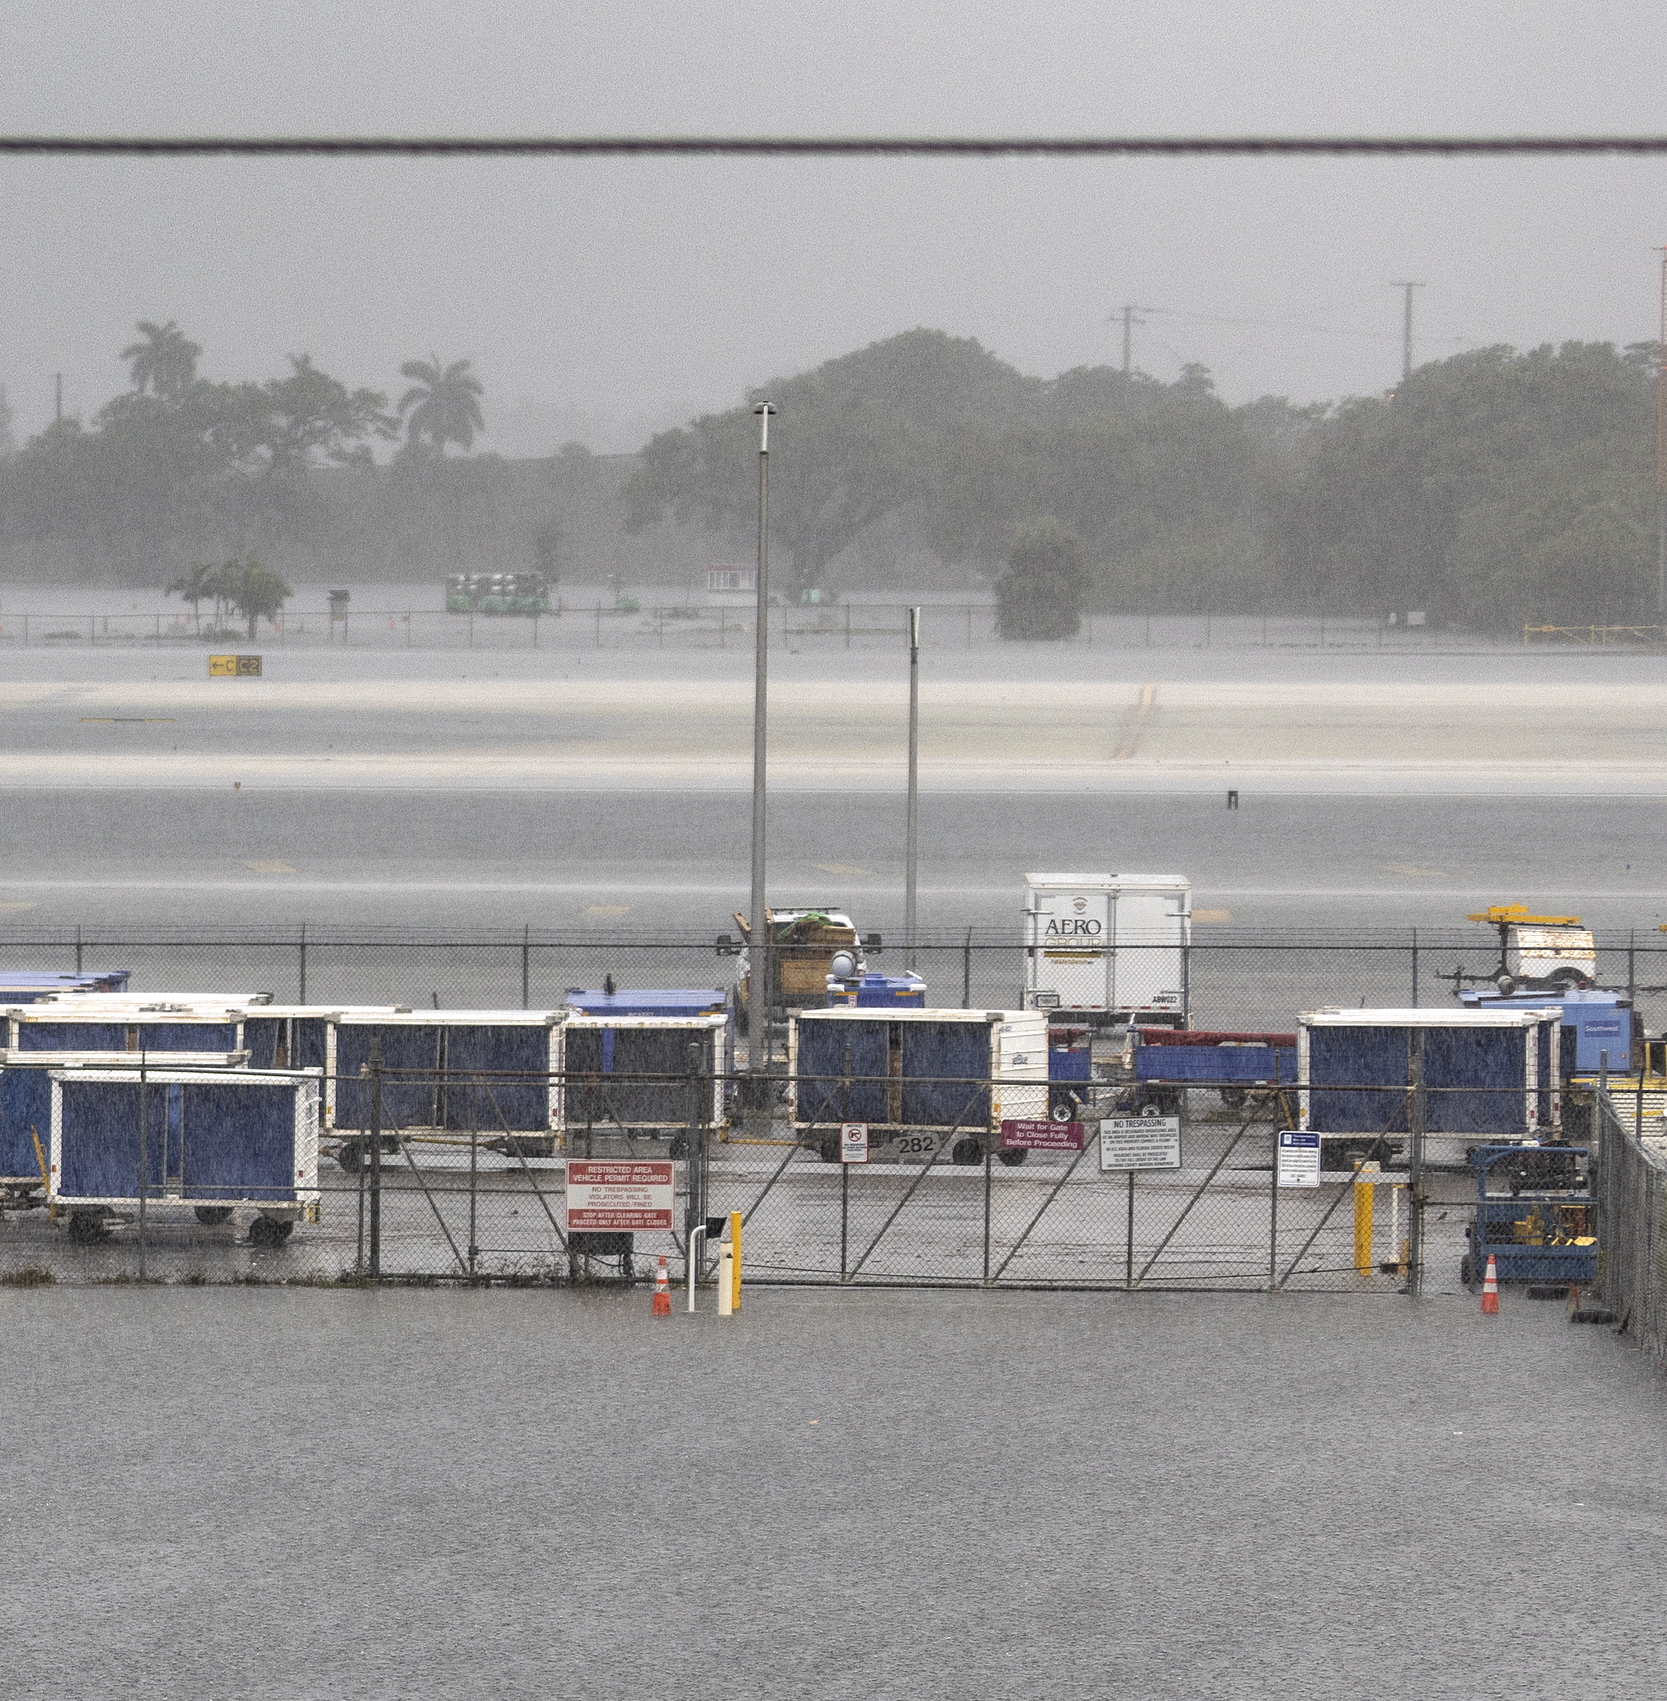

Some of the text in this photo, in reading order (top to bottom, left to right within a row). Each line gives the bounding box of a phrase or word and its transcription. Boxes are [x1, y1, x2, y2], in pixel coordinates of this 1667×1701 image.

[1045, 919, 1101, 935] AERO
[1017, 1122, 1034, 1130] Wait
[1050, 1123, 1068, 1132] Gate
[1126, 1119, 1166, 1127] TRESPASSING
[1026, 1131, 1047, 1139] Close
[1050, 1132, 1069, 1140] Fully
[899, 1136, 934, 1154] 282
[1034, 1140, 1078, 1148] Proceeding
